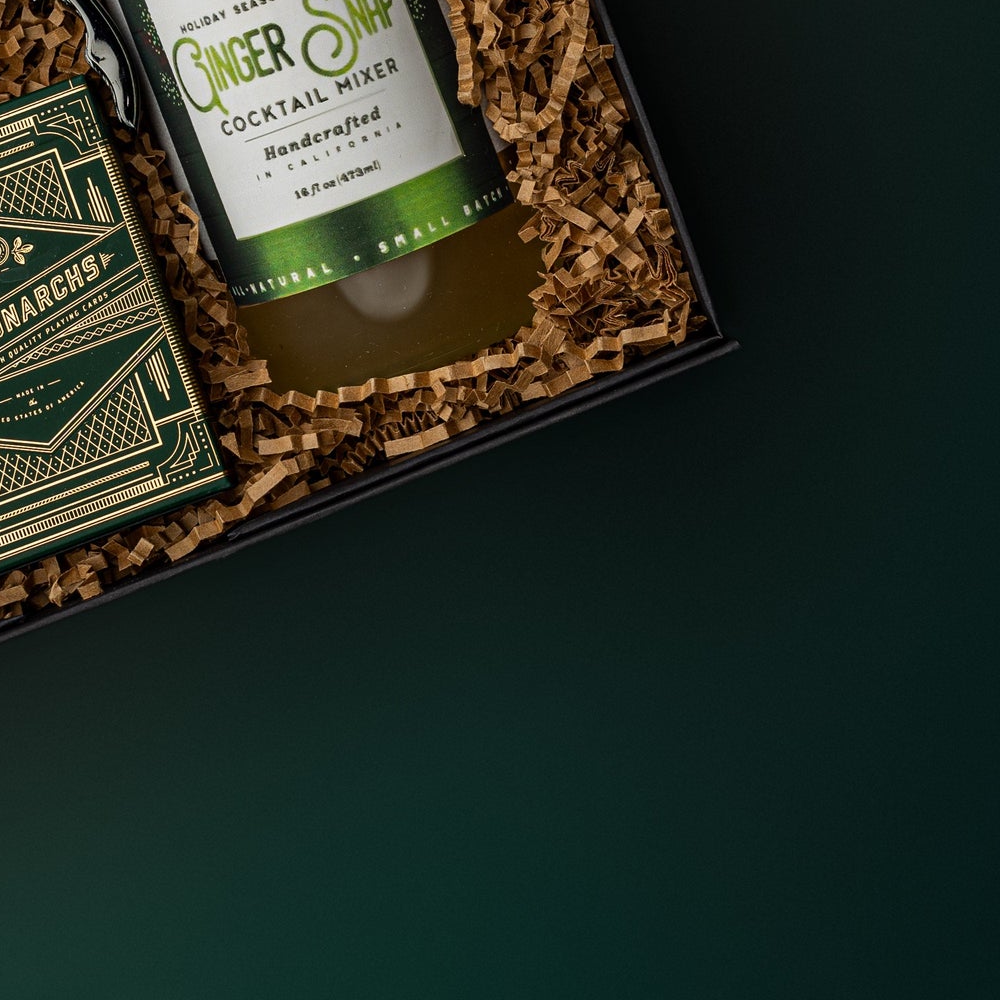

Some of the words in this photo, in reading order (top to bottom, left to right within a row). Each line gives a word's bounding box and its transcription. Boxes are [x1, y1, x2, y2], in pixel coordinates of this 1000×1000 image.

[180, 9, 227, 34] HOLIDAY
[172, 22, 295, 116] GINGER
[220, 87, 329, 136] COCKTAIL
[334, 57, 399, 95] MIXER
[256, 171, 272, 181] IN
[287, 121, 402, 171] CALIFORNIA
[263, 105, 382, 161] Handcrafted
[294, 187, 310, 200] 16
[322, 179, 337, 190] oz
[378, 216, 450, 254] SMALL
[462, 186, 503, 217] BATCH
[8, 332, 42, 359] QUALITY
[45, 309, 80, 335] PLAYING
[82, 291, 109, 312] CARDS
[14, 408, 43, 421] STATES
[57, 381, 85, 404] AMERICA
[15, 387, 34, 399] MADE
